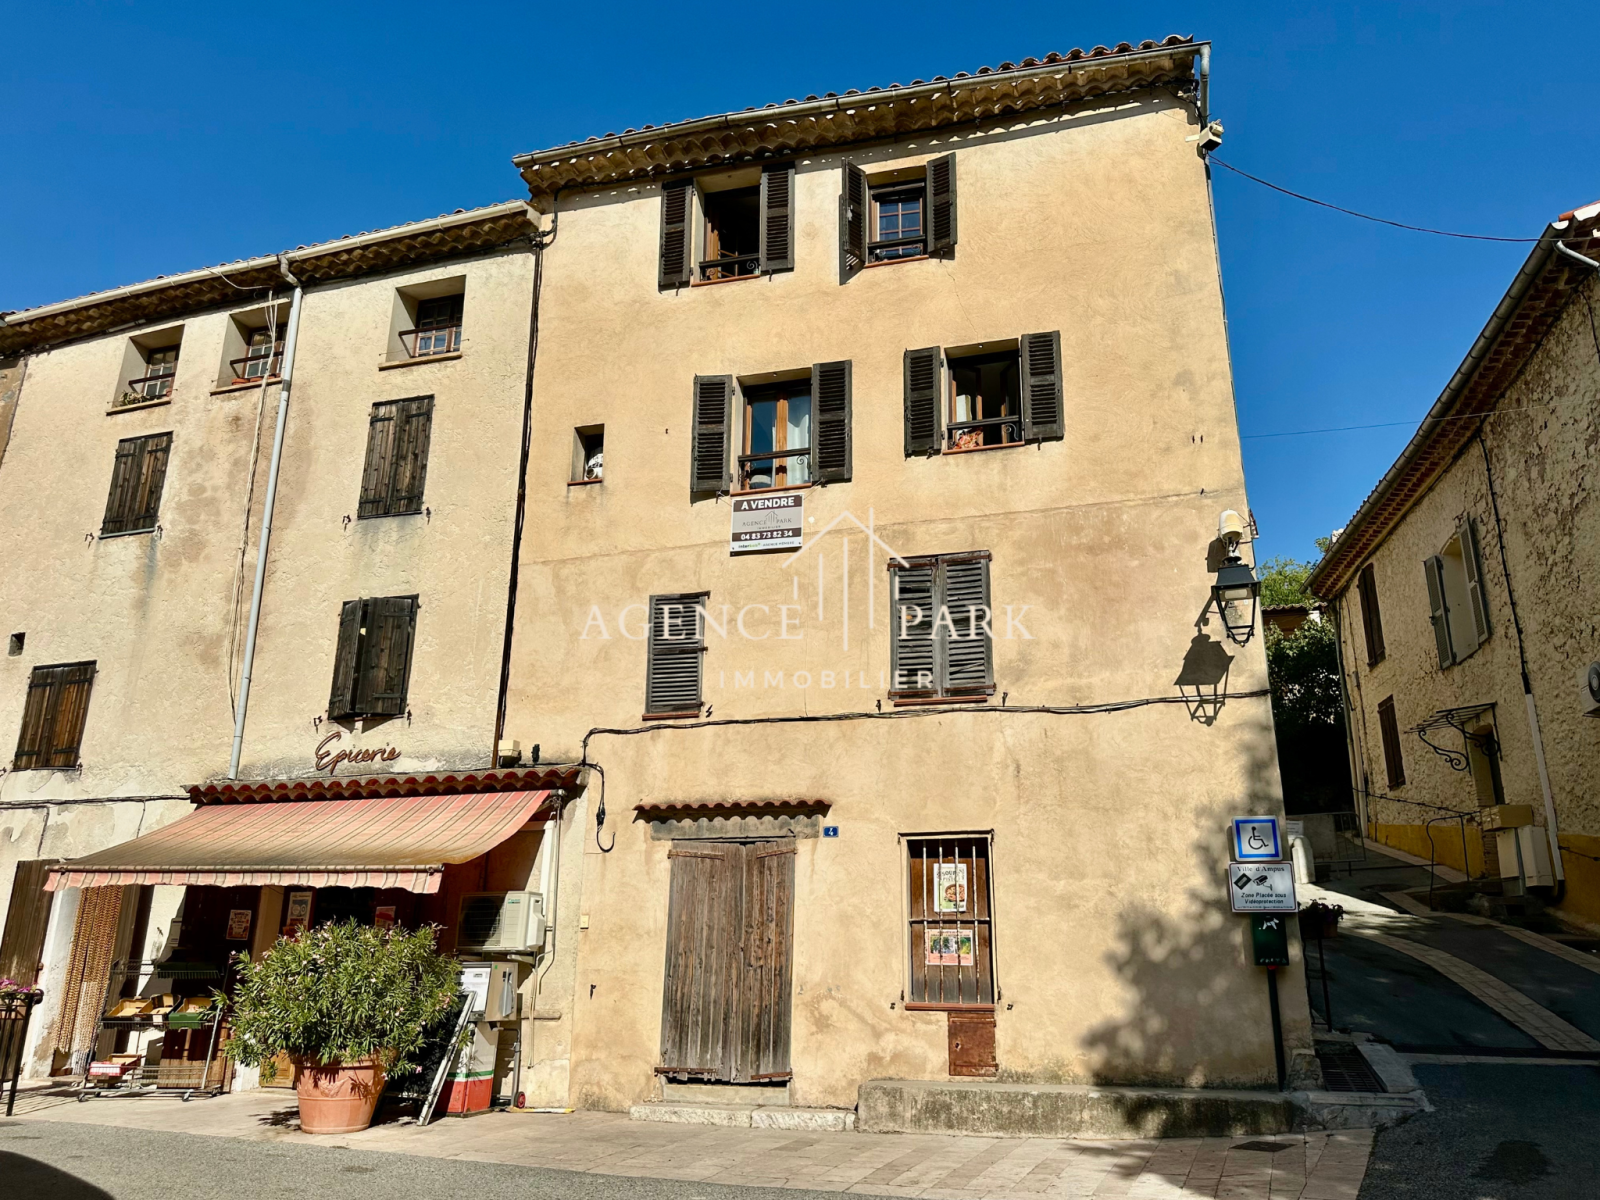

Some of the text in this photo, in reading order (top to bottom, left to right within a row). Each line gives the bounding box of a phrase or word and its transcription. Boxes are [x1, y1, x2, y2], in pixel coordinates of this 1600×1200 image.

[741, 497, 795, 510] A VENDRE
[742, 519, 767, 527] AGENCE
[741, 533, 750, 541] 04
[751, 532, 761, 540] 83
[762, 531, 771, 539] 73
[772, 530, 782, 538] 82
[315, 731, 402, 776] Epicerie
